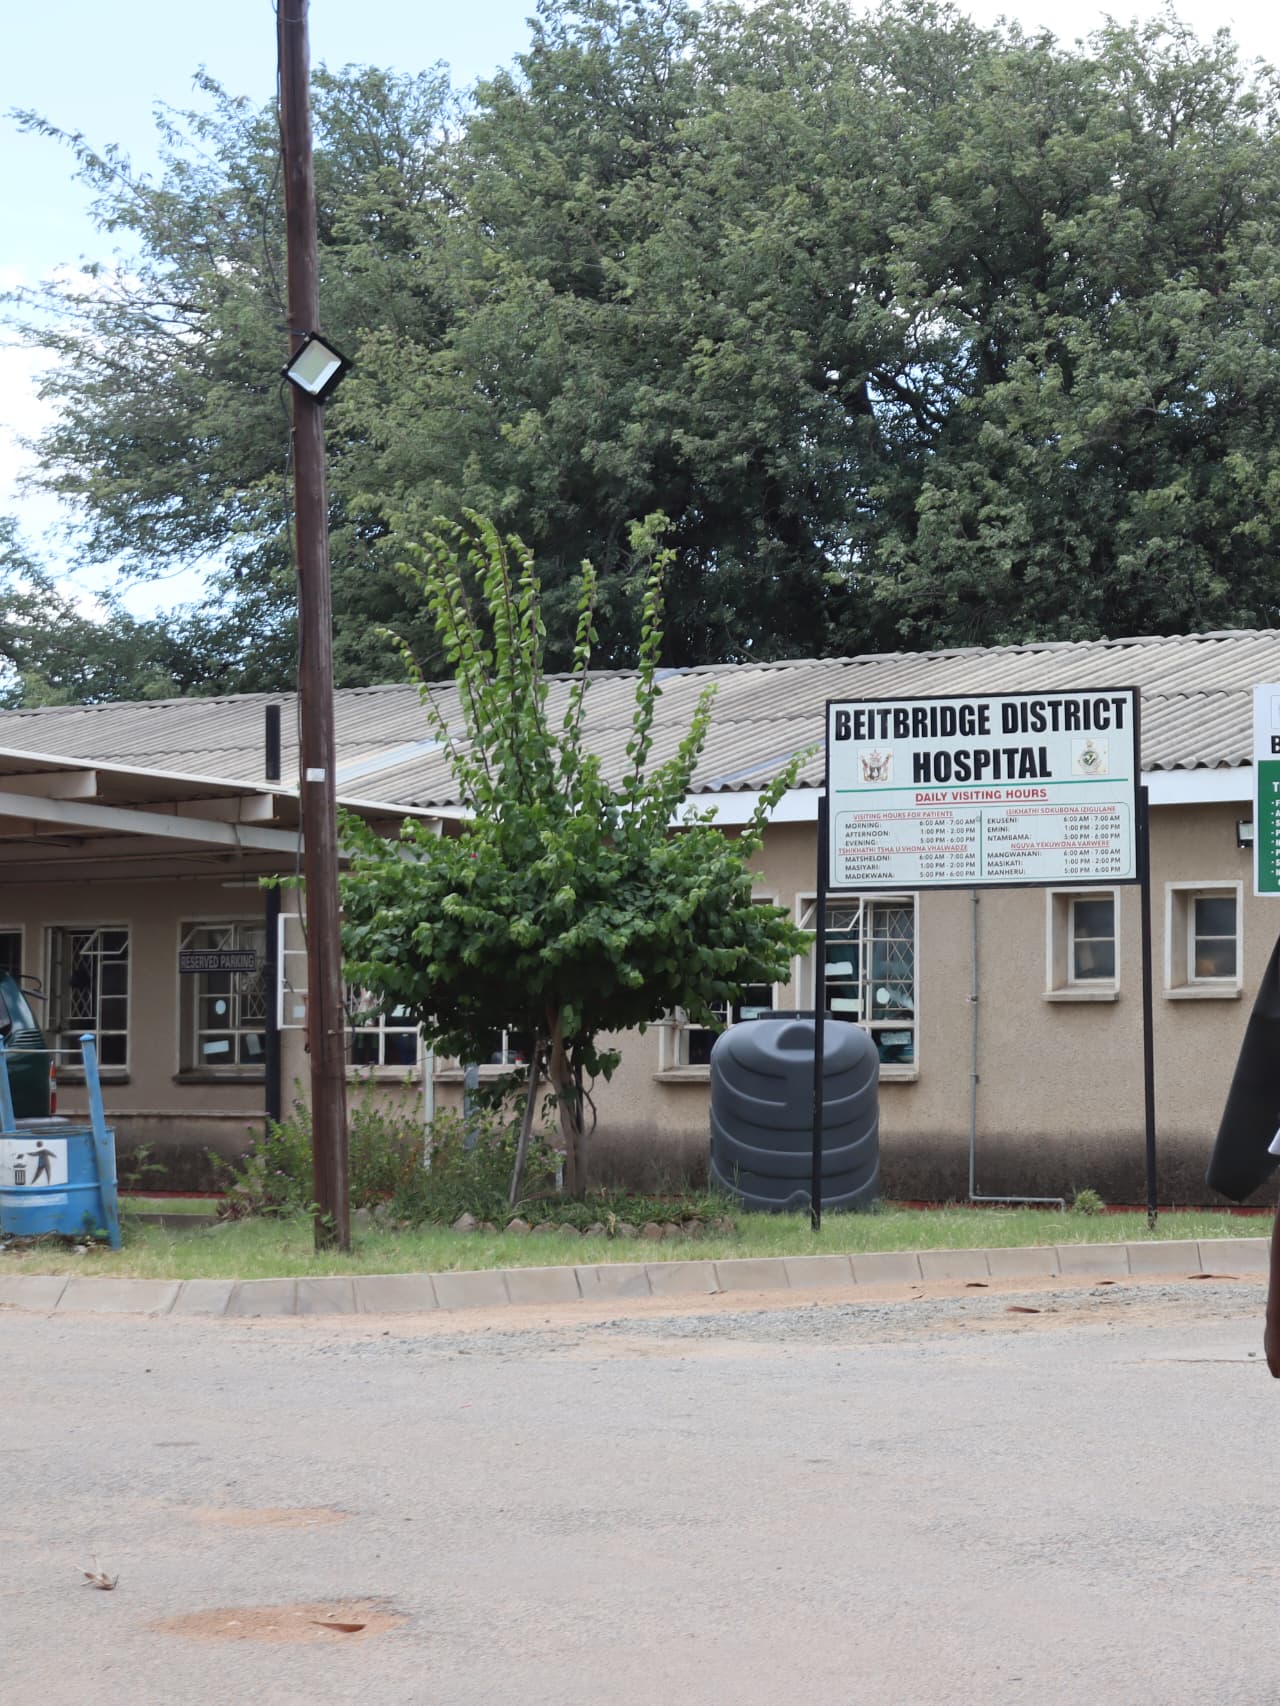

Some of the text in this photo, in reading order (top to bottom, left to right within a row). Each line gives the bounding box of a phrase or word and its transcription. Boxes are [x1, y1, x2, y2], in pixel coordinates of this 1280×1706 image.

[835, 698, 1127, 741] BEITBRIDGE DISTRICT
[912, 746, 1052, 784] HOSPITAL
[915, 788, 1047, 803] DAILY VISITING HOURS
[181, 954, 254, 968] RESERVED PARKING
